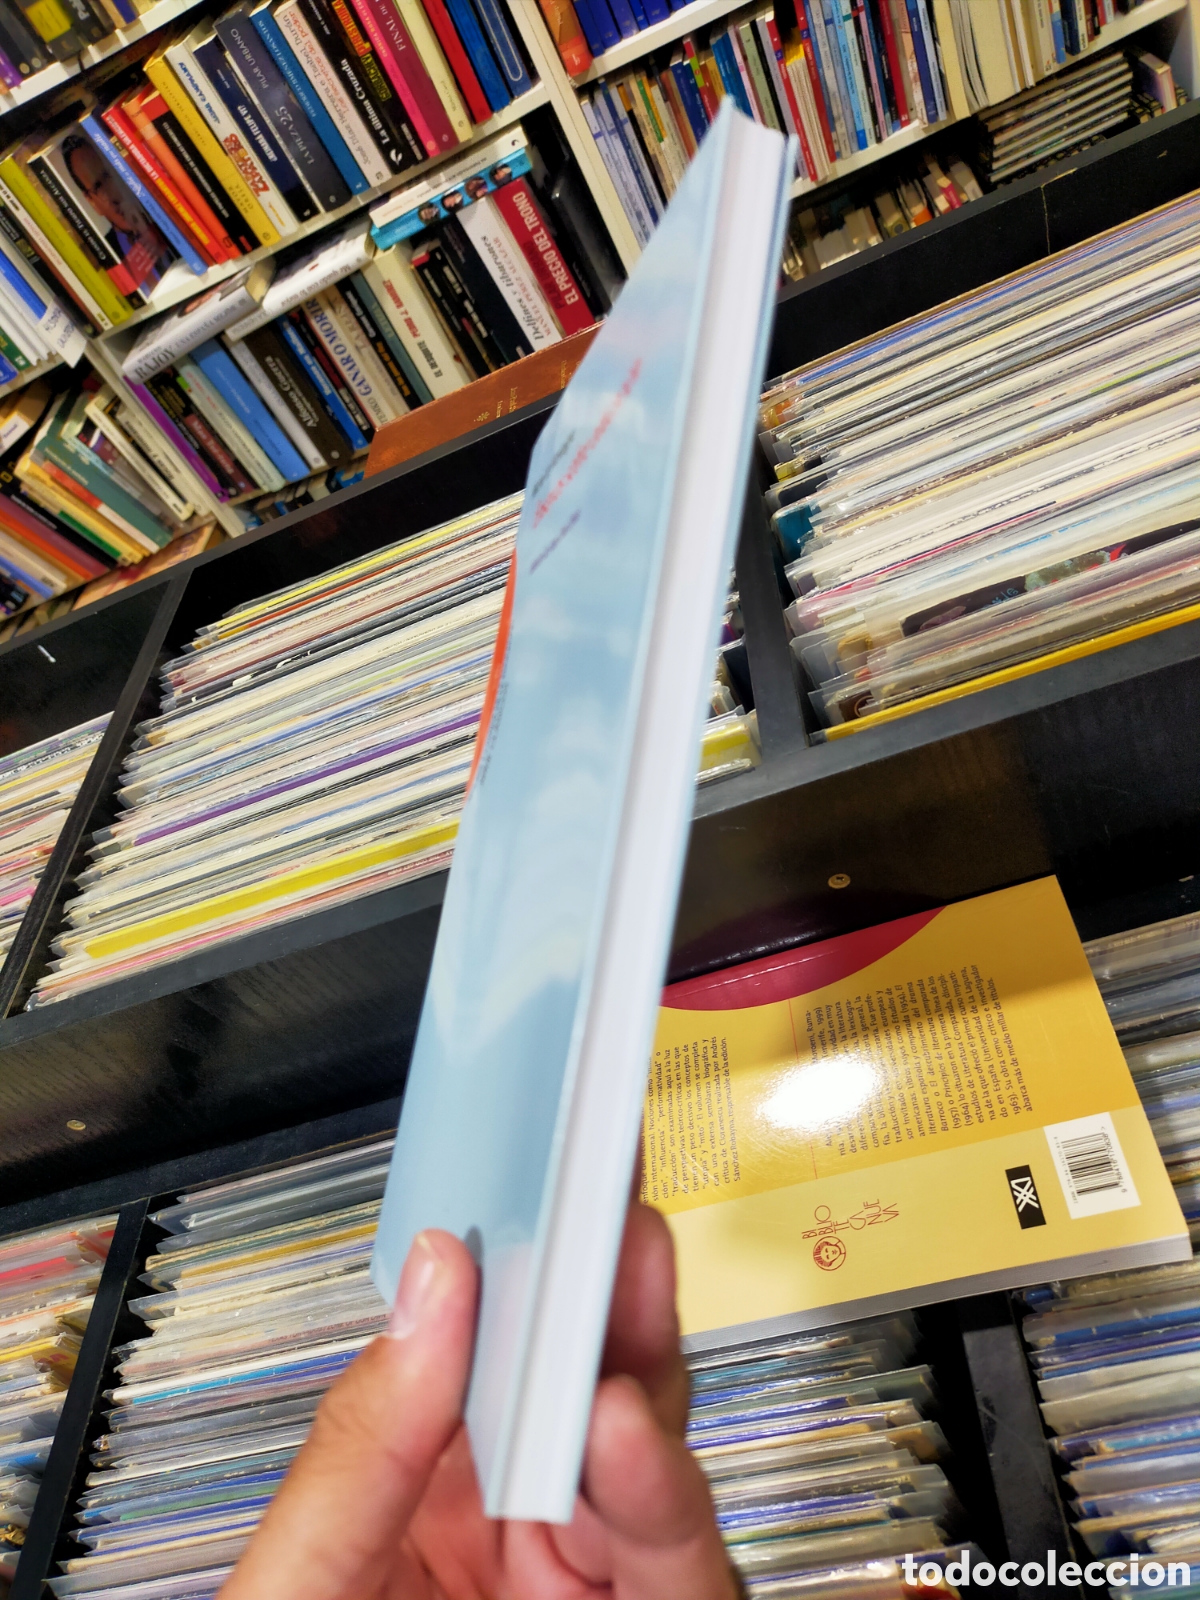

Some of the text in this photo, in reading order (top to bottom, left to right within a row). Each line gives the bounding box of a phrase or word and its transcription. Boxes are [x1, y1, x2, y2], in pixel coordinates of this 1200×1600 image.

[282, 14, 303, 46] Durán
[288, 11, 309, 38] poder
[385, 18, 406, 51] FINAL
[230, 28, 256, 66] URBANO
[299, 46, 321, 79] Isabel
[252, 66, 269, 89] PILAR
[340, 58, 366, 100] Cruzada
[243, 114, 261, 136] FELIPE
[362, 99, 383, 130] última
[512, 191, 539, 231] TRONO
[481, 235, 514, 287] tiburones
[542, 249, 572, 291] PRECIO
[301, 296, 336, 344] MORIR
[517, 297, 544, 340] Delfines
[135, 345, 176, 380] RAJOY
[339, 354, 372, 396] GANAR
[814, 1007, 823, 1024] 1999)
[835, 1001, 844, 1033] literatura
[846, 999, 855, 1030] lexicogra-
[856, 1004, 868, 1031] general,
[865, 994, 875, 1012] profe-
[888, 997, 899, 1023] Estudios
[933, 996, 941, 1012] línea
[894, 1025, 903, 1043] como
[938, 1013, 951, 1040] primera
[949, 971, 989, 1089] que ofreció primer curso imparti-
[961, 966, 1000, 1091] España (Universidad Laguna,
[971, 965, 1009, 1077] obra crítico investigador
[692, 1041, 700, 1071] completa
[877, 996, 909, 1124] invitado europeas
[899, 1045, 909, 1065] suyos
[907, 982, 948, 1131] Barroco descubrimiento del drama
[917, 979, 961, 1128] (1957) Principios literatura comparada
[938, 974, 984, 1123] estudios Literatura Comparada, discipli-
[987, 978, 1032, 1111] abarca medio millar títulos.
[702, 1046, 710, 1078] biográfica
[903, 1015, 936, 1134] literatura española comparada
[950, 1061, 962, 1092] situaron
[705, 1081, 713, 1117] semblanza
[724, 1078, 733, 1116] responsable
[960, 1102, 973, 1126] (1964)
[889, 1101, 902, 1142] traducción
[680, 1135, 688, 1181] perspectivas
[732, 1151, 740, 1181] Sánchez
